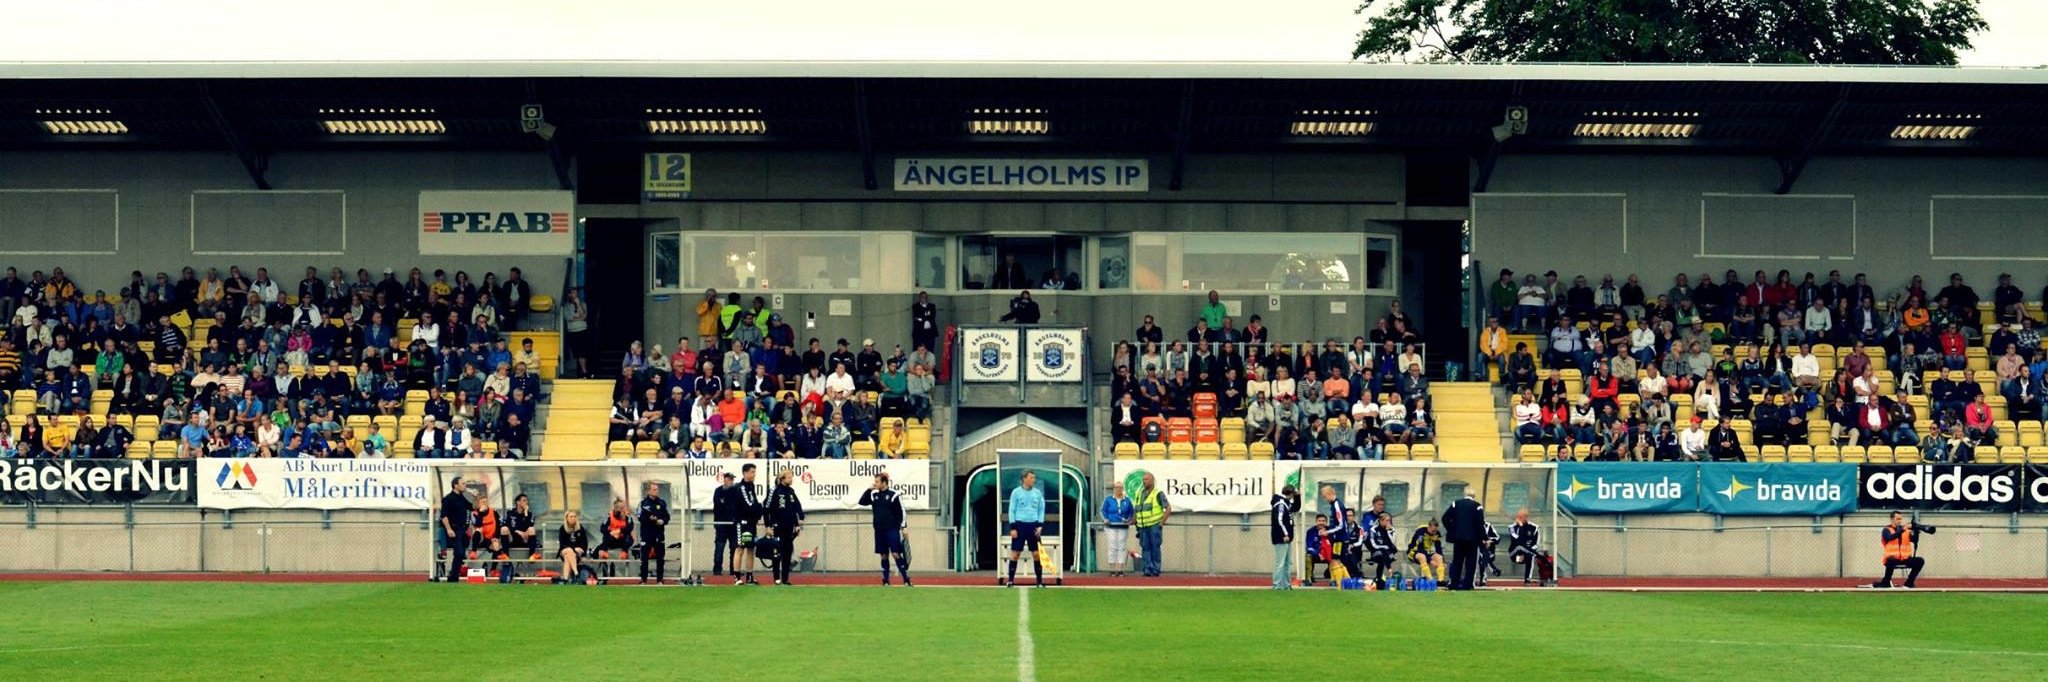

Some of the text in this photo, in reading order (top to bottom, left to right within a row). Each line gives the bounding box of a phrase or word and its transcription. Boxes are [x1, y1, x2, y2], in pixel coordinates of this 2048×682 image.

[650, 154, 685, 180] 12
[903, 160, 1140, 185] ÄNGELHOLMS IP
[440, 212, 551, 233] PEAB
[283, 460, 429, 473] AB Kurt Lundström
[688, 460, 723, 476] Dekor
[850, 460, 886, 476] Dekor
[283, 477, 427, 500] Målerifirma
[809, 480, 849, 500] Design
[1166, 477, 1263, 496] Backahill
[1598, 477, 1681, 499] bravida
[1757, 478, 1841, 501] bravida
[1866, 464, 2014, 503] adidas
